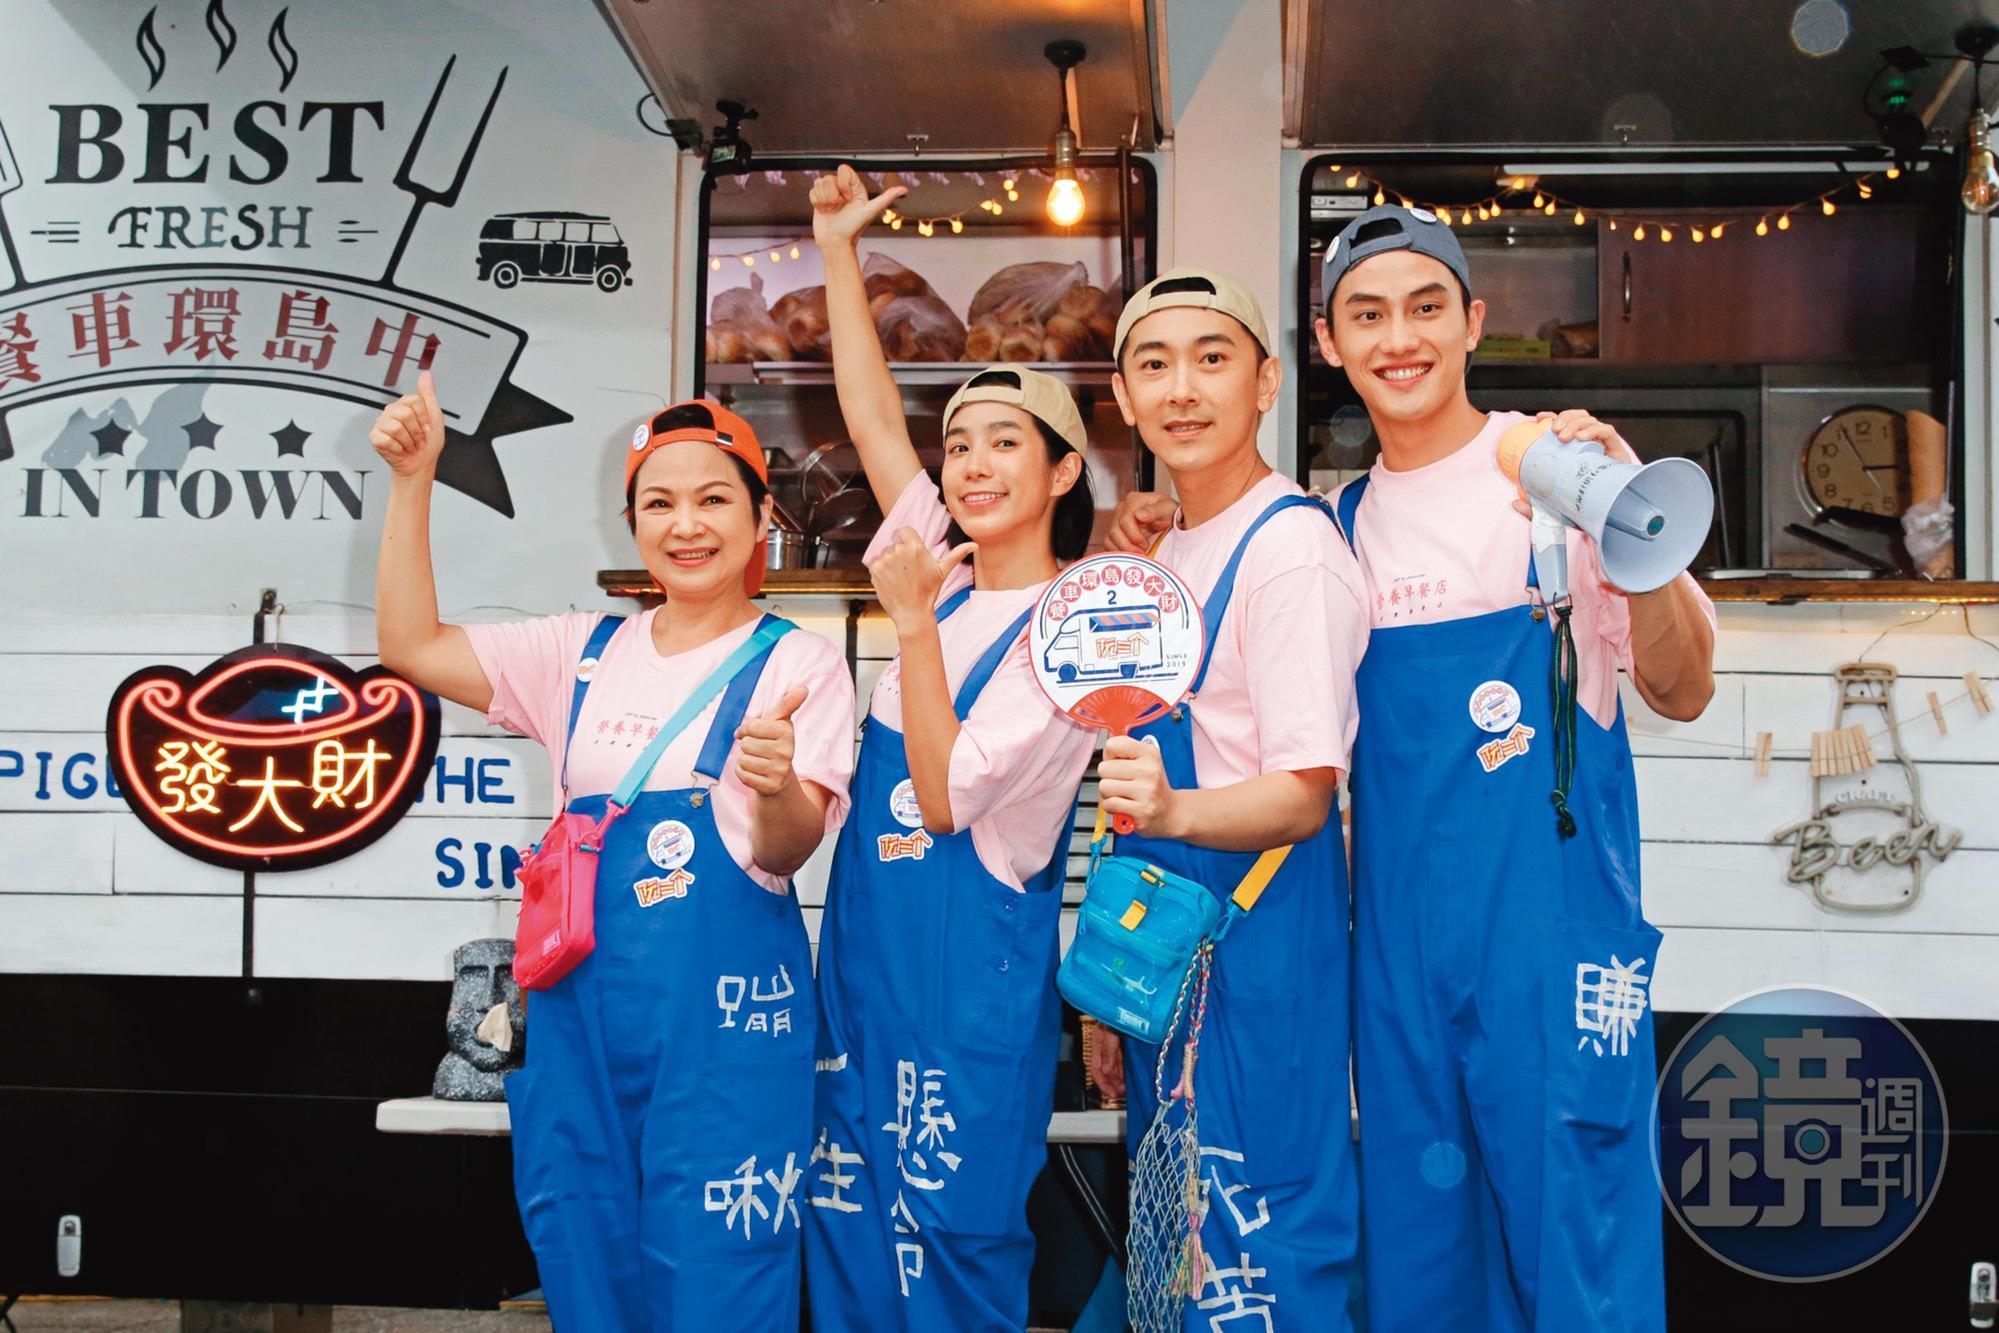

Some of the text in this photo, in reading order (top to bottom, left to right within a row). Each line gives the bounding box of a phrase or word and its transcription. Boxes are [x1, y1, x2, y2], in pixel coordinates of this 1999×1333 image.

[44, 100, 385, 186] BEST
[108, 204, 314, 251] FRESH
[1822, 443, 1839, 458] 10
[1855, 421, 1871, 436] 12
[17, 468, 374, 520] IN TOWN
[1824, 484, 1837, 498] 8
[1048, 565, 1180, 622] 餐車環島發大財
[1106, 590, 1118, 605] 2
[155, 738, 392, 833] 發大財
[415, 755, 515, 804] HE
[1774, 819, 1962, 883] Beer
[1575, 953, 1649, 1058] 賺
